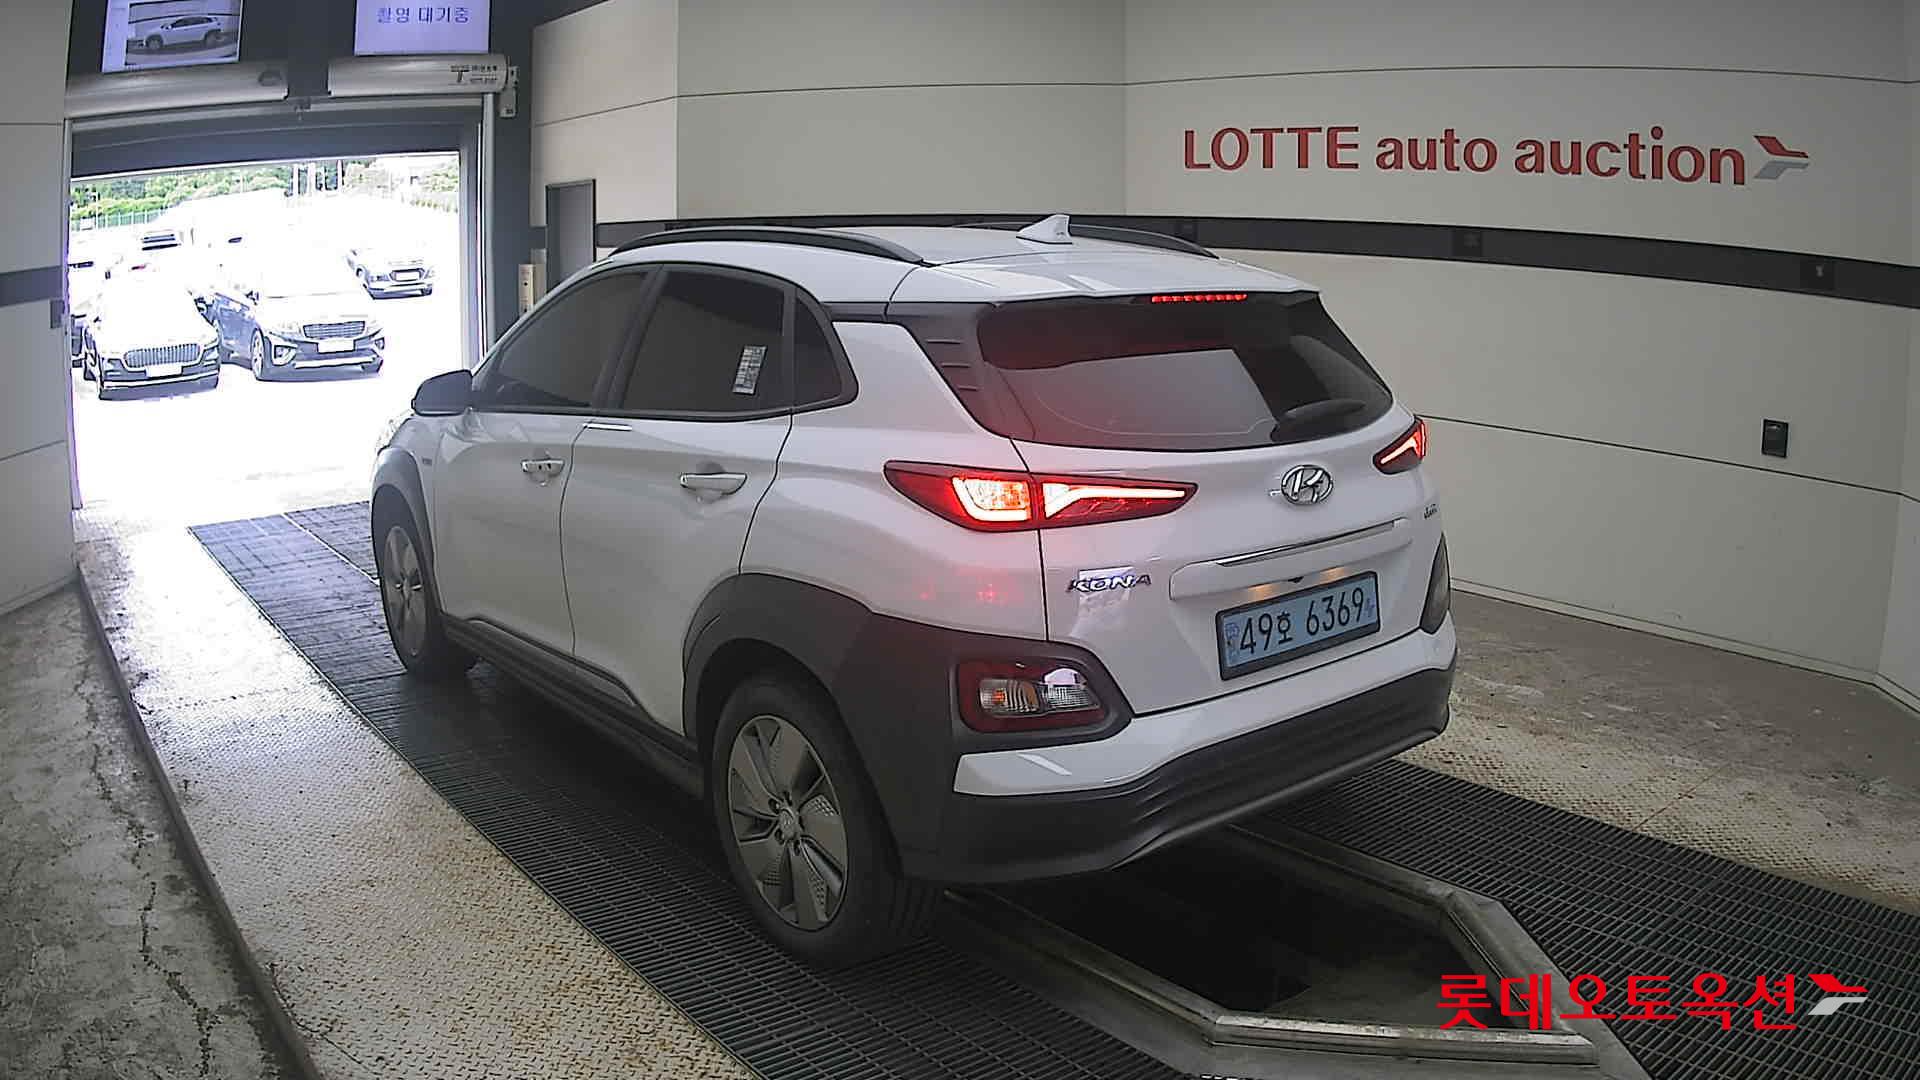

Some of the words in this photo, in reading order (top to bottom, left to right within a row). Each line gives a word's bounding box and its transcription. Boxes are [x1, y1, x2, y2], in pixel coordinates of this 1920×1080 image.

[418, 6, 469, 23] 대기중
[1184, 126, 1360, 170] LOTTE
[1375, 128, 1498, 172] auto
[1514, 126, 1746, 185] auction
[1065, 574, 1152, 592] KONA
[1240, 611, 1292, 654] 49호
[1306, 587, 1364, 636] 6369
